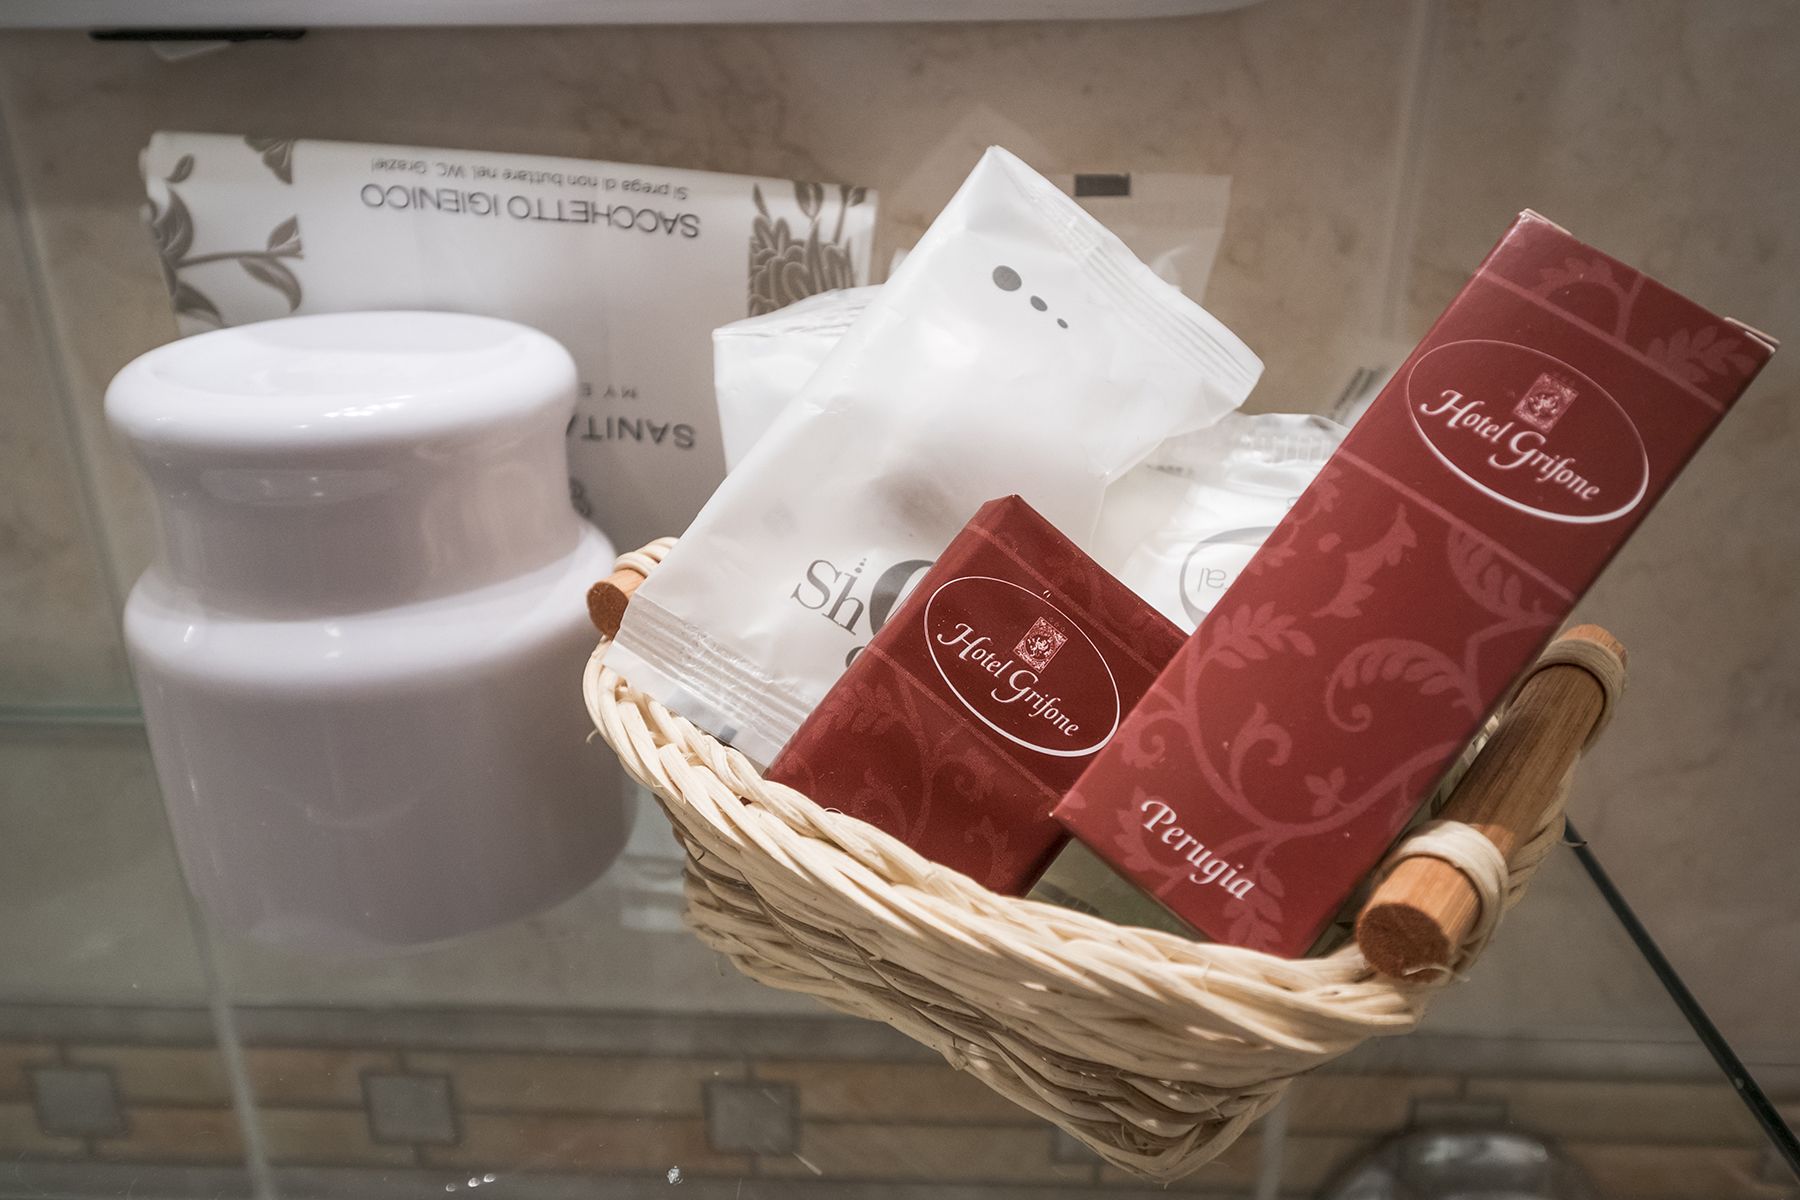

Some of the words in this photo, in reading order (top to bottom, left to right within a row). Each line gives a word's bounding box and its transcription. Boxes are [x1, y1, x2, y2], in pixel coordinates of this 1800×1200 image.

[502, 167, 563, 186] buttare
[567, 174, 598, 187] non
[602, 177, 617, 191] di
[621, 179, 670, 196] prega
[360, 183, 499, 216] IGIENICO
[673, 186, 689, 200] Si
[506, 195, 700, 238] SACCHETTO
[1419, 389, 1515, 444] Hotel
[1487, 430, 1601, 501] Grifone
[936, 622, 1015, 679] Hotel
[990, 669, 1080, 737] Grifone
[1140, 799, 1256, 901] Perugia
